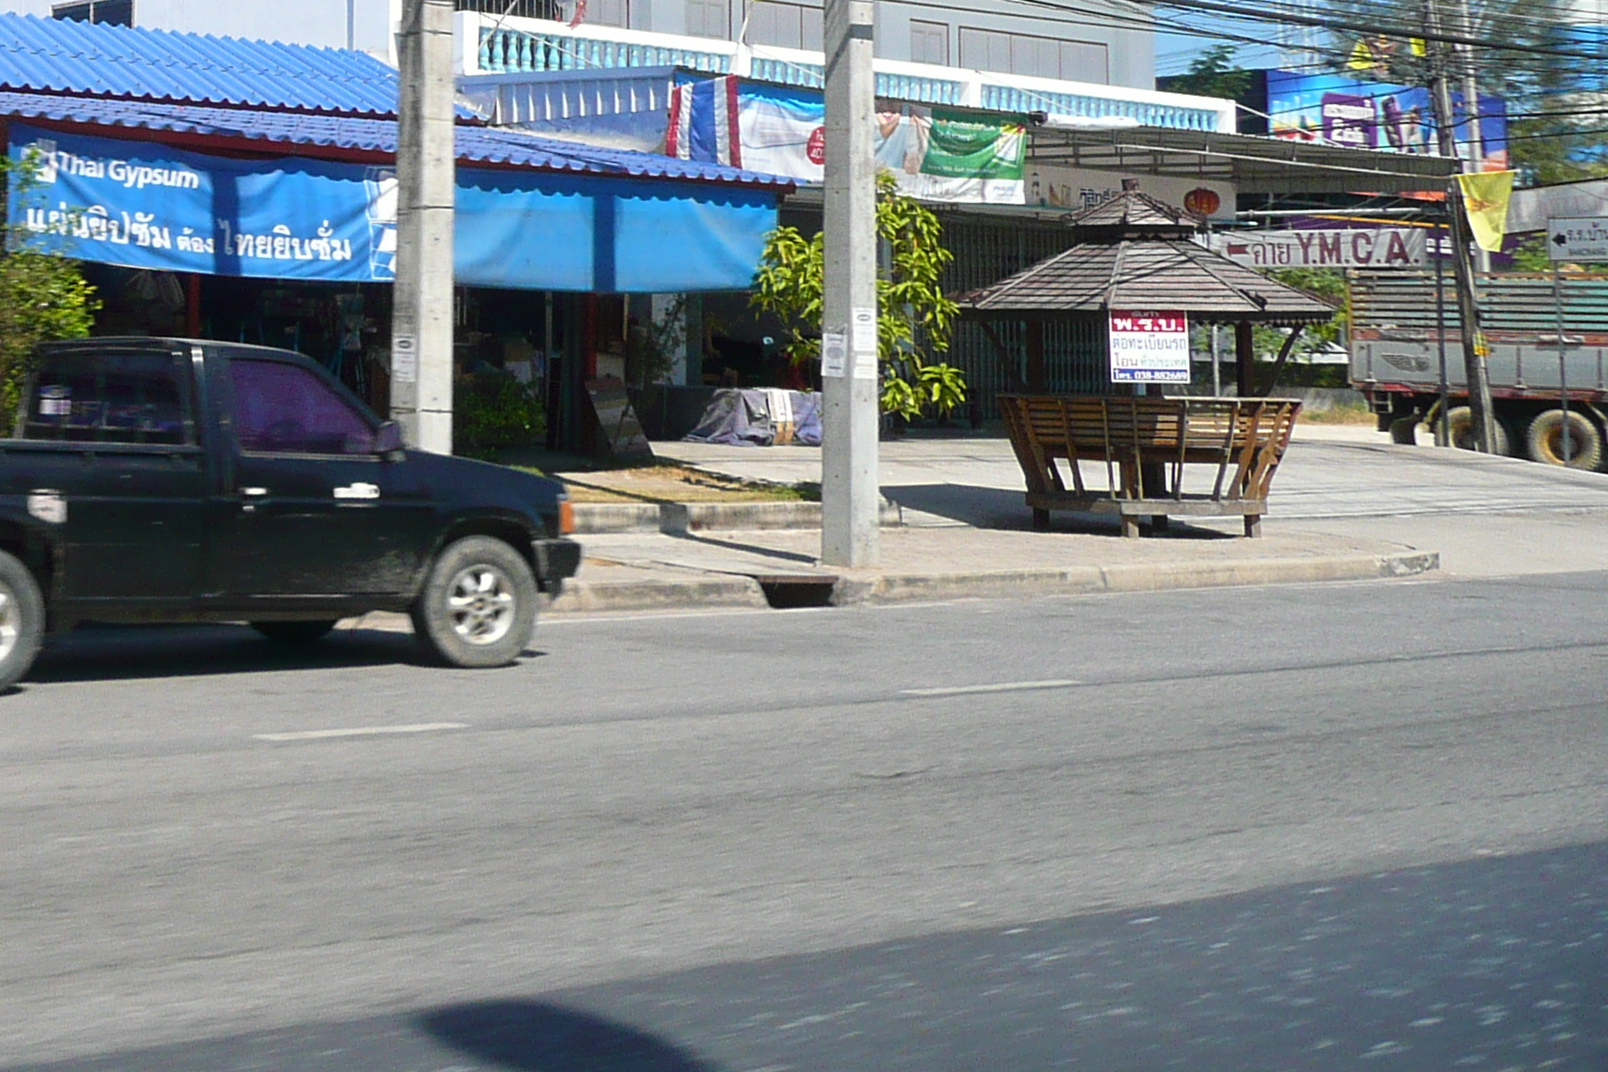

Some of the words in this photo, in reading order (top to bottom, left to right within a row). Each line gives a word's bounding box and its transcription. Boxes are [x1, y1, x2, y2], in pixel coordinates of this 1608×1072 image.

[57, 151, 105, 178] Thai
[108, 161, 199, 189] Gypsum
[176, 226, 214, 254] ต้อง
[1293, 230, 1420, 265] Y.M.C.A.
[1113, 318, 1184, 331] พ.ร.บ.
[1112, 333, 1187, 350] ต่อทะเบียนรถ
[1114, 352, 1138, 367] โอน
